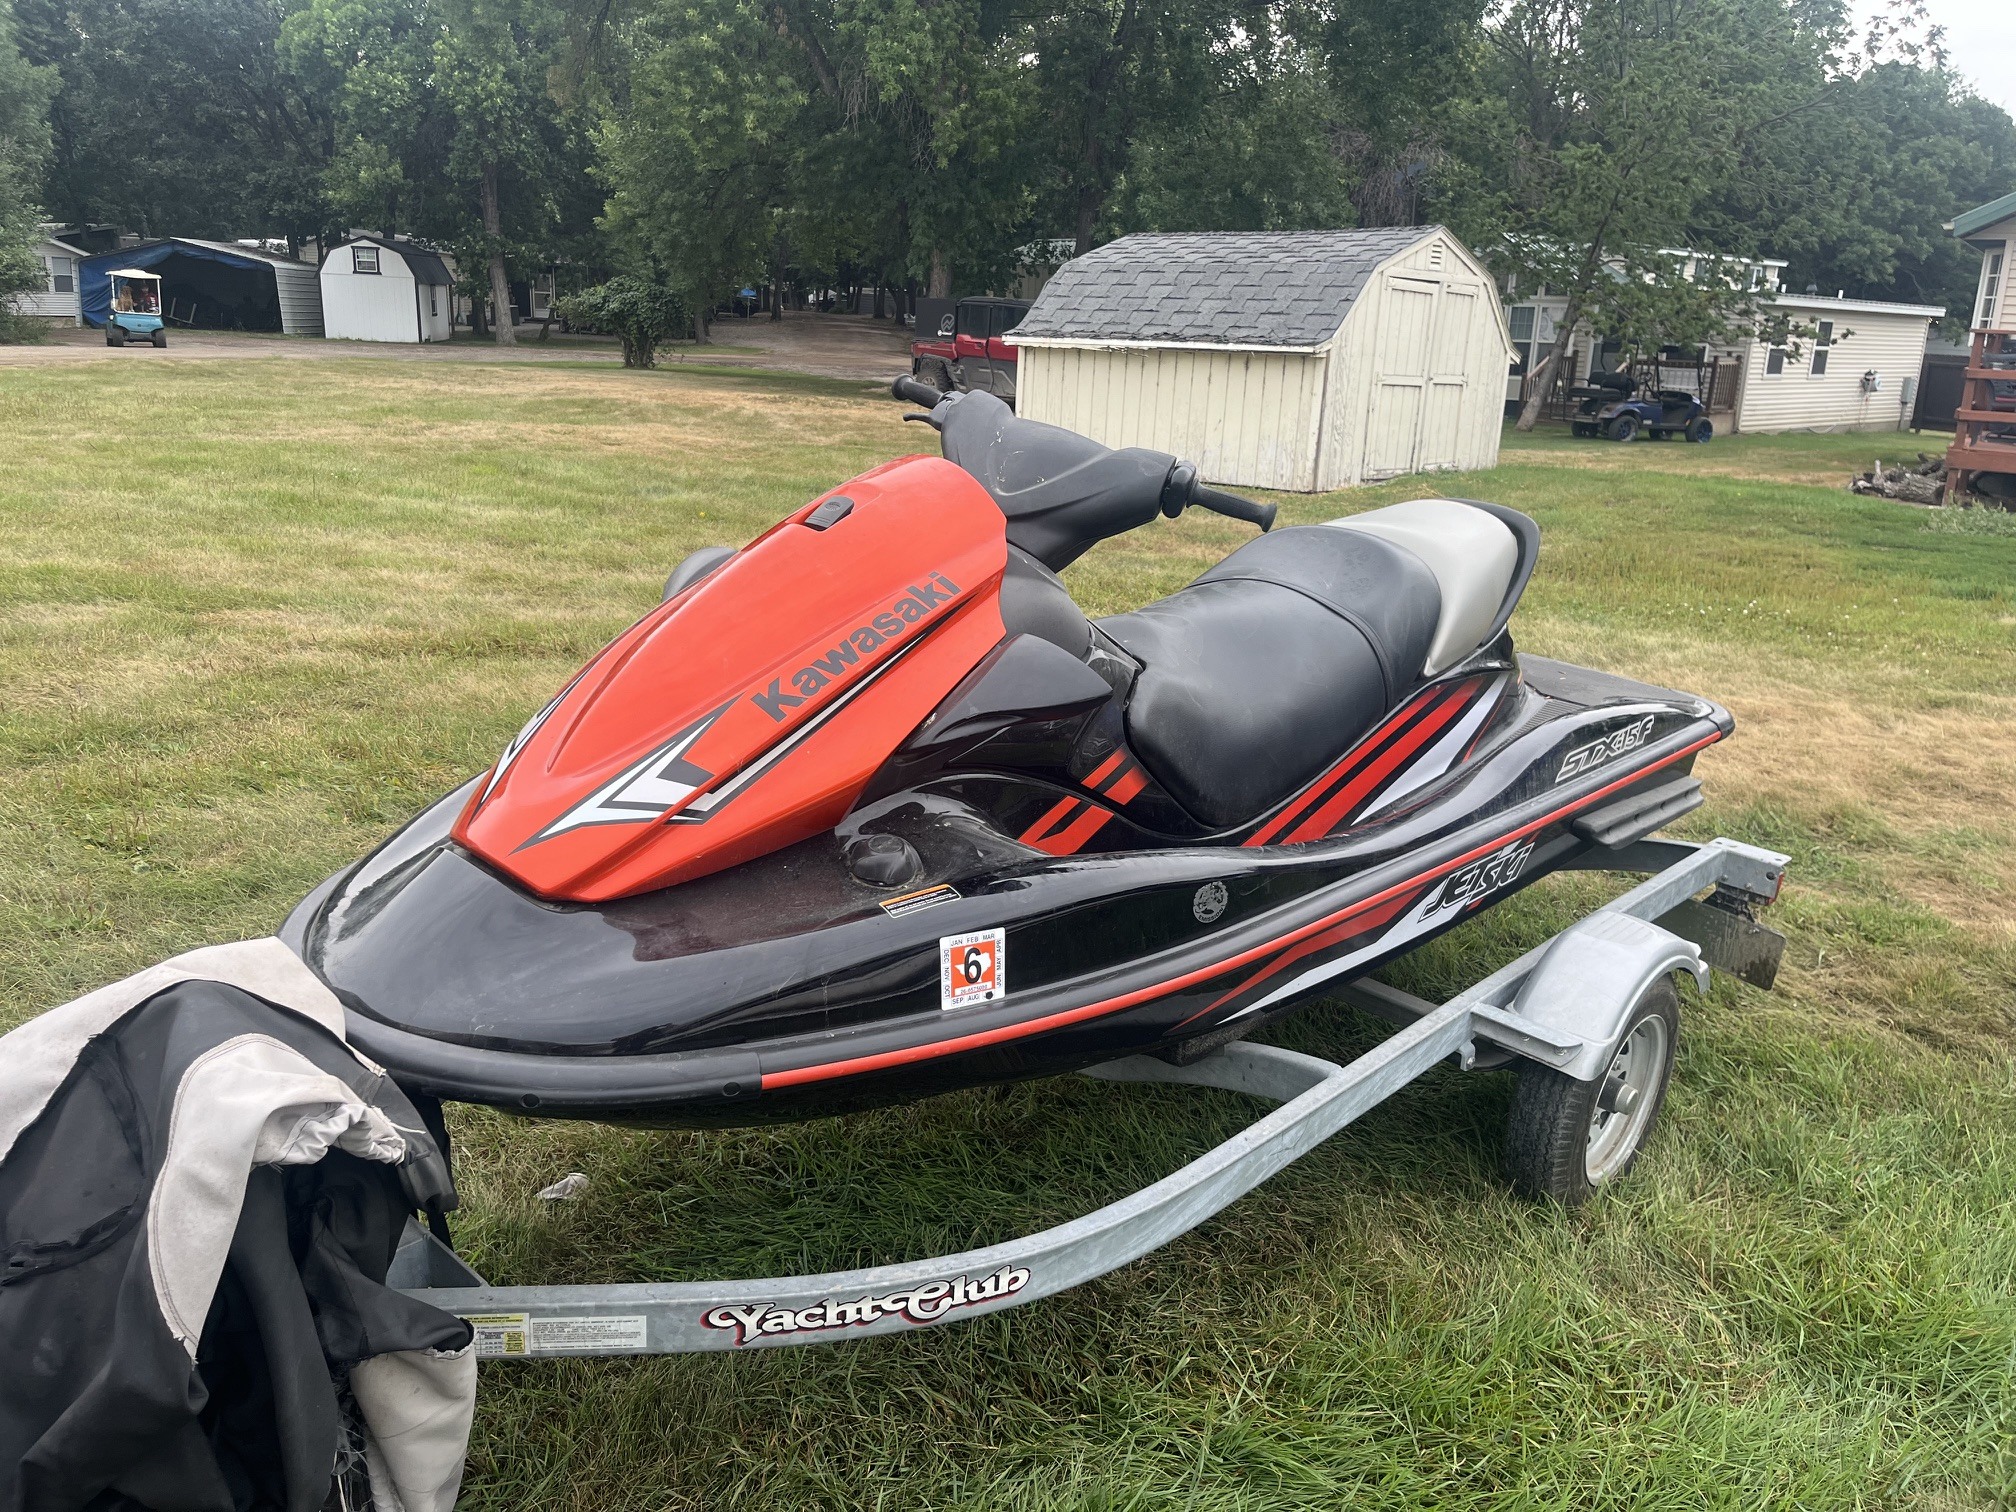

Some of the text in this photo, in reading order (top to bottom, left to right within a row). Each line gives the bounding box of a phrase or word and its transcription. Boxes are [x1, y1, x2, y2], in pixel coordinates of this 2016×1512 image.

[750, 571, 962, 723] Kawasaki
[951, 938, 963, 947] JAN
[964, 947, 982, 984] 6
[952, 997, 964, 1005] SEP
